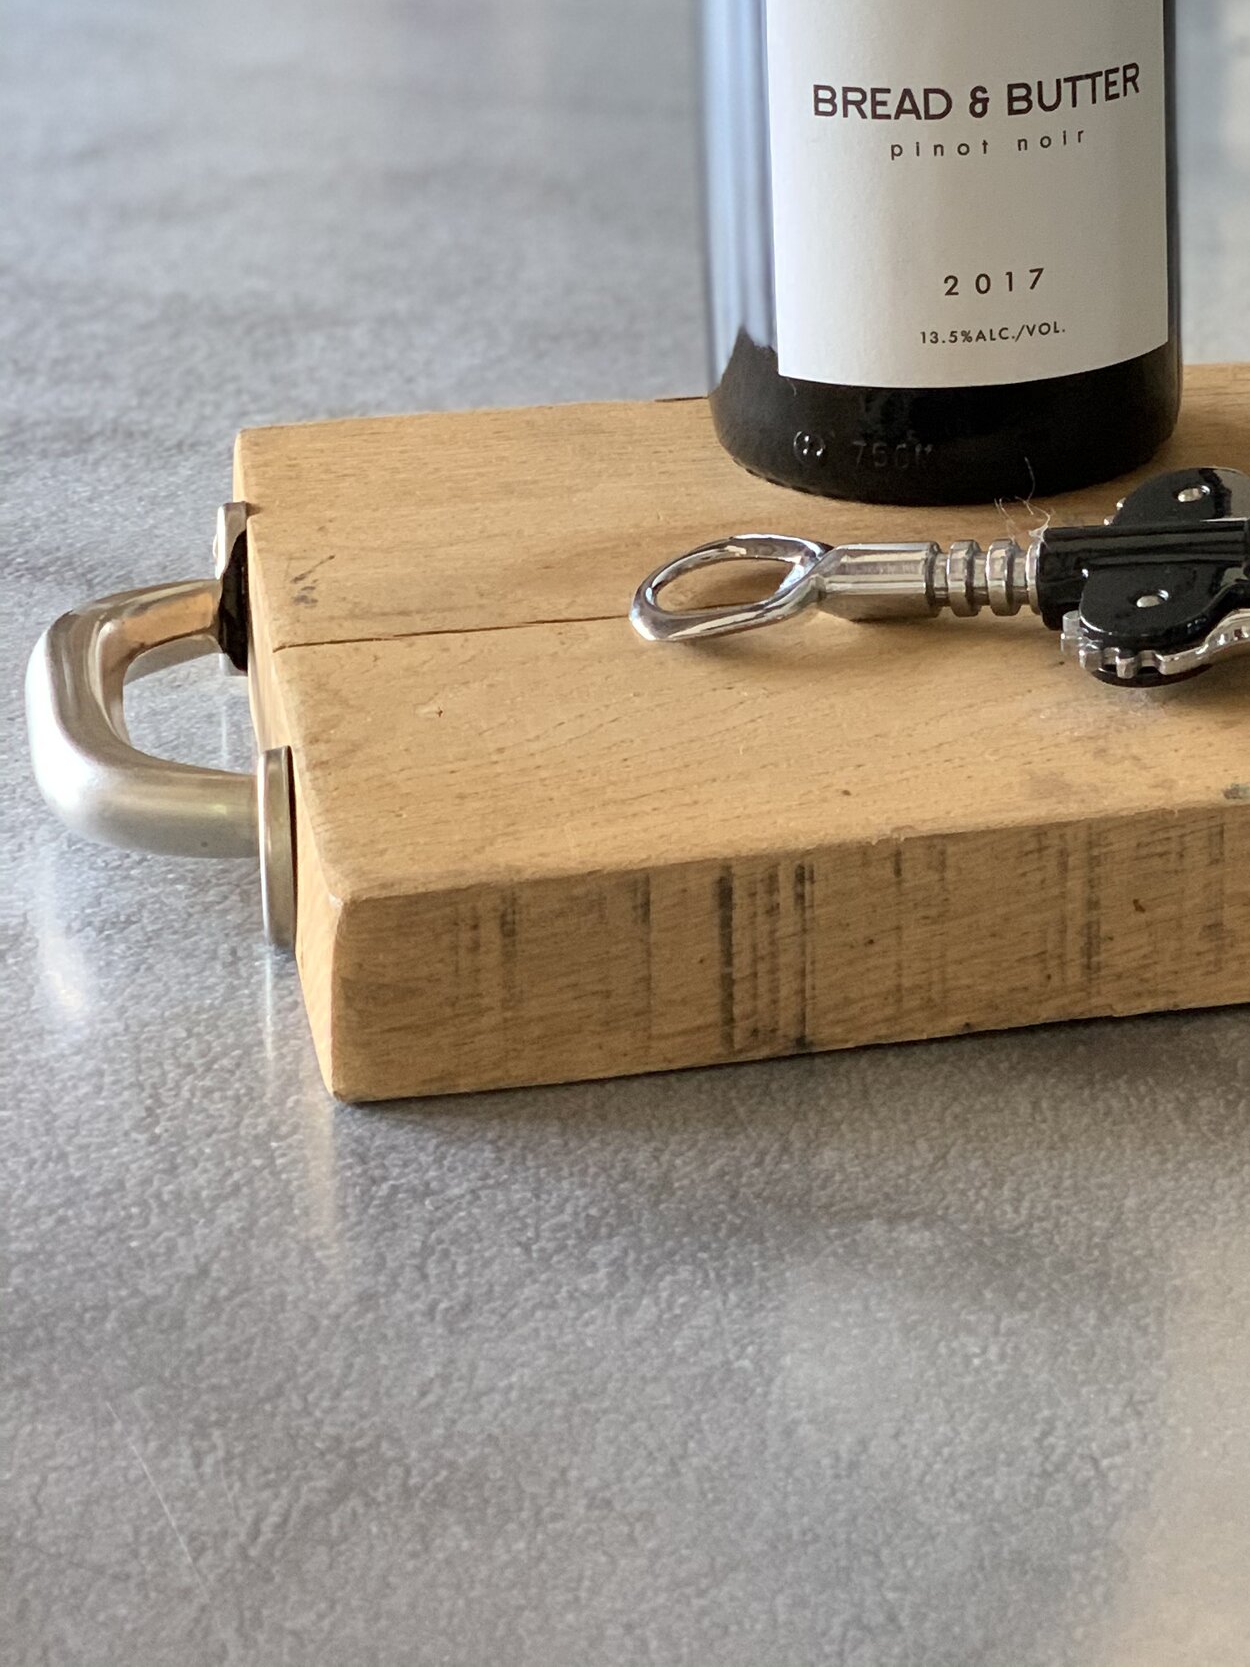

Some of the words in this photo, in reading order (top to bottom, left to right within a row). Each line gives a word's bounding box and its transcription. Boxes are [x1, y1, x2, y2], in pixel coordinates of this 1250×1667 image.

[812, 83, 953, 121] BREAD
[968, 85, 990, 119] &
[1006, 62, 1140, 117] BUTTER
[890, 139, 989, 161] pinot
[1017, 129, 1085, 152] noir
[943, 267, 1045, 297] 2017
